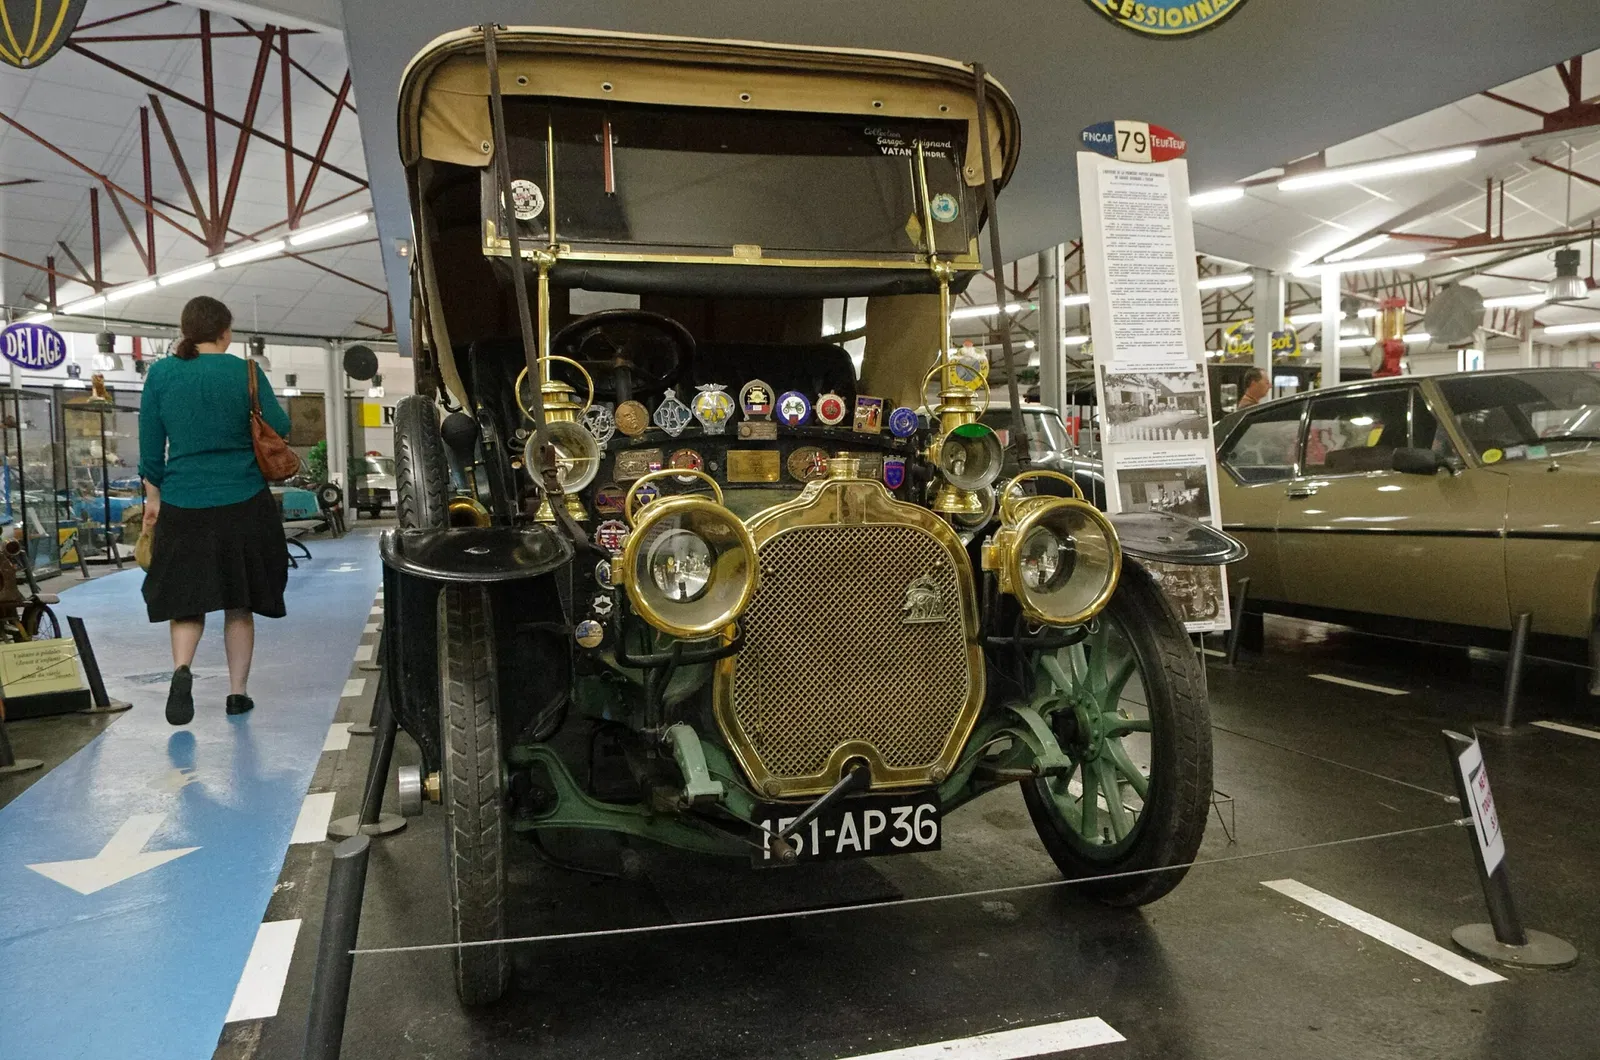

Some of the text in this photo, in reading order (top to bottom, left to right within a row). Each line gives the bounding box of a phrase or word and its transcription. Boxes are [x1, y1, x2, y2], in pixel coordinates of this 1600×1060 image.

[863, 127, 901, 138] Collection
[876, 137, 905, 147] Garage
[1117, 130, 1147, 154] 79
[881, 146, 912, 157] VATAN
[5, 327, 62, 366] DELAGE
